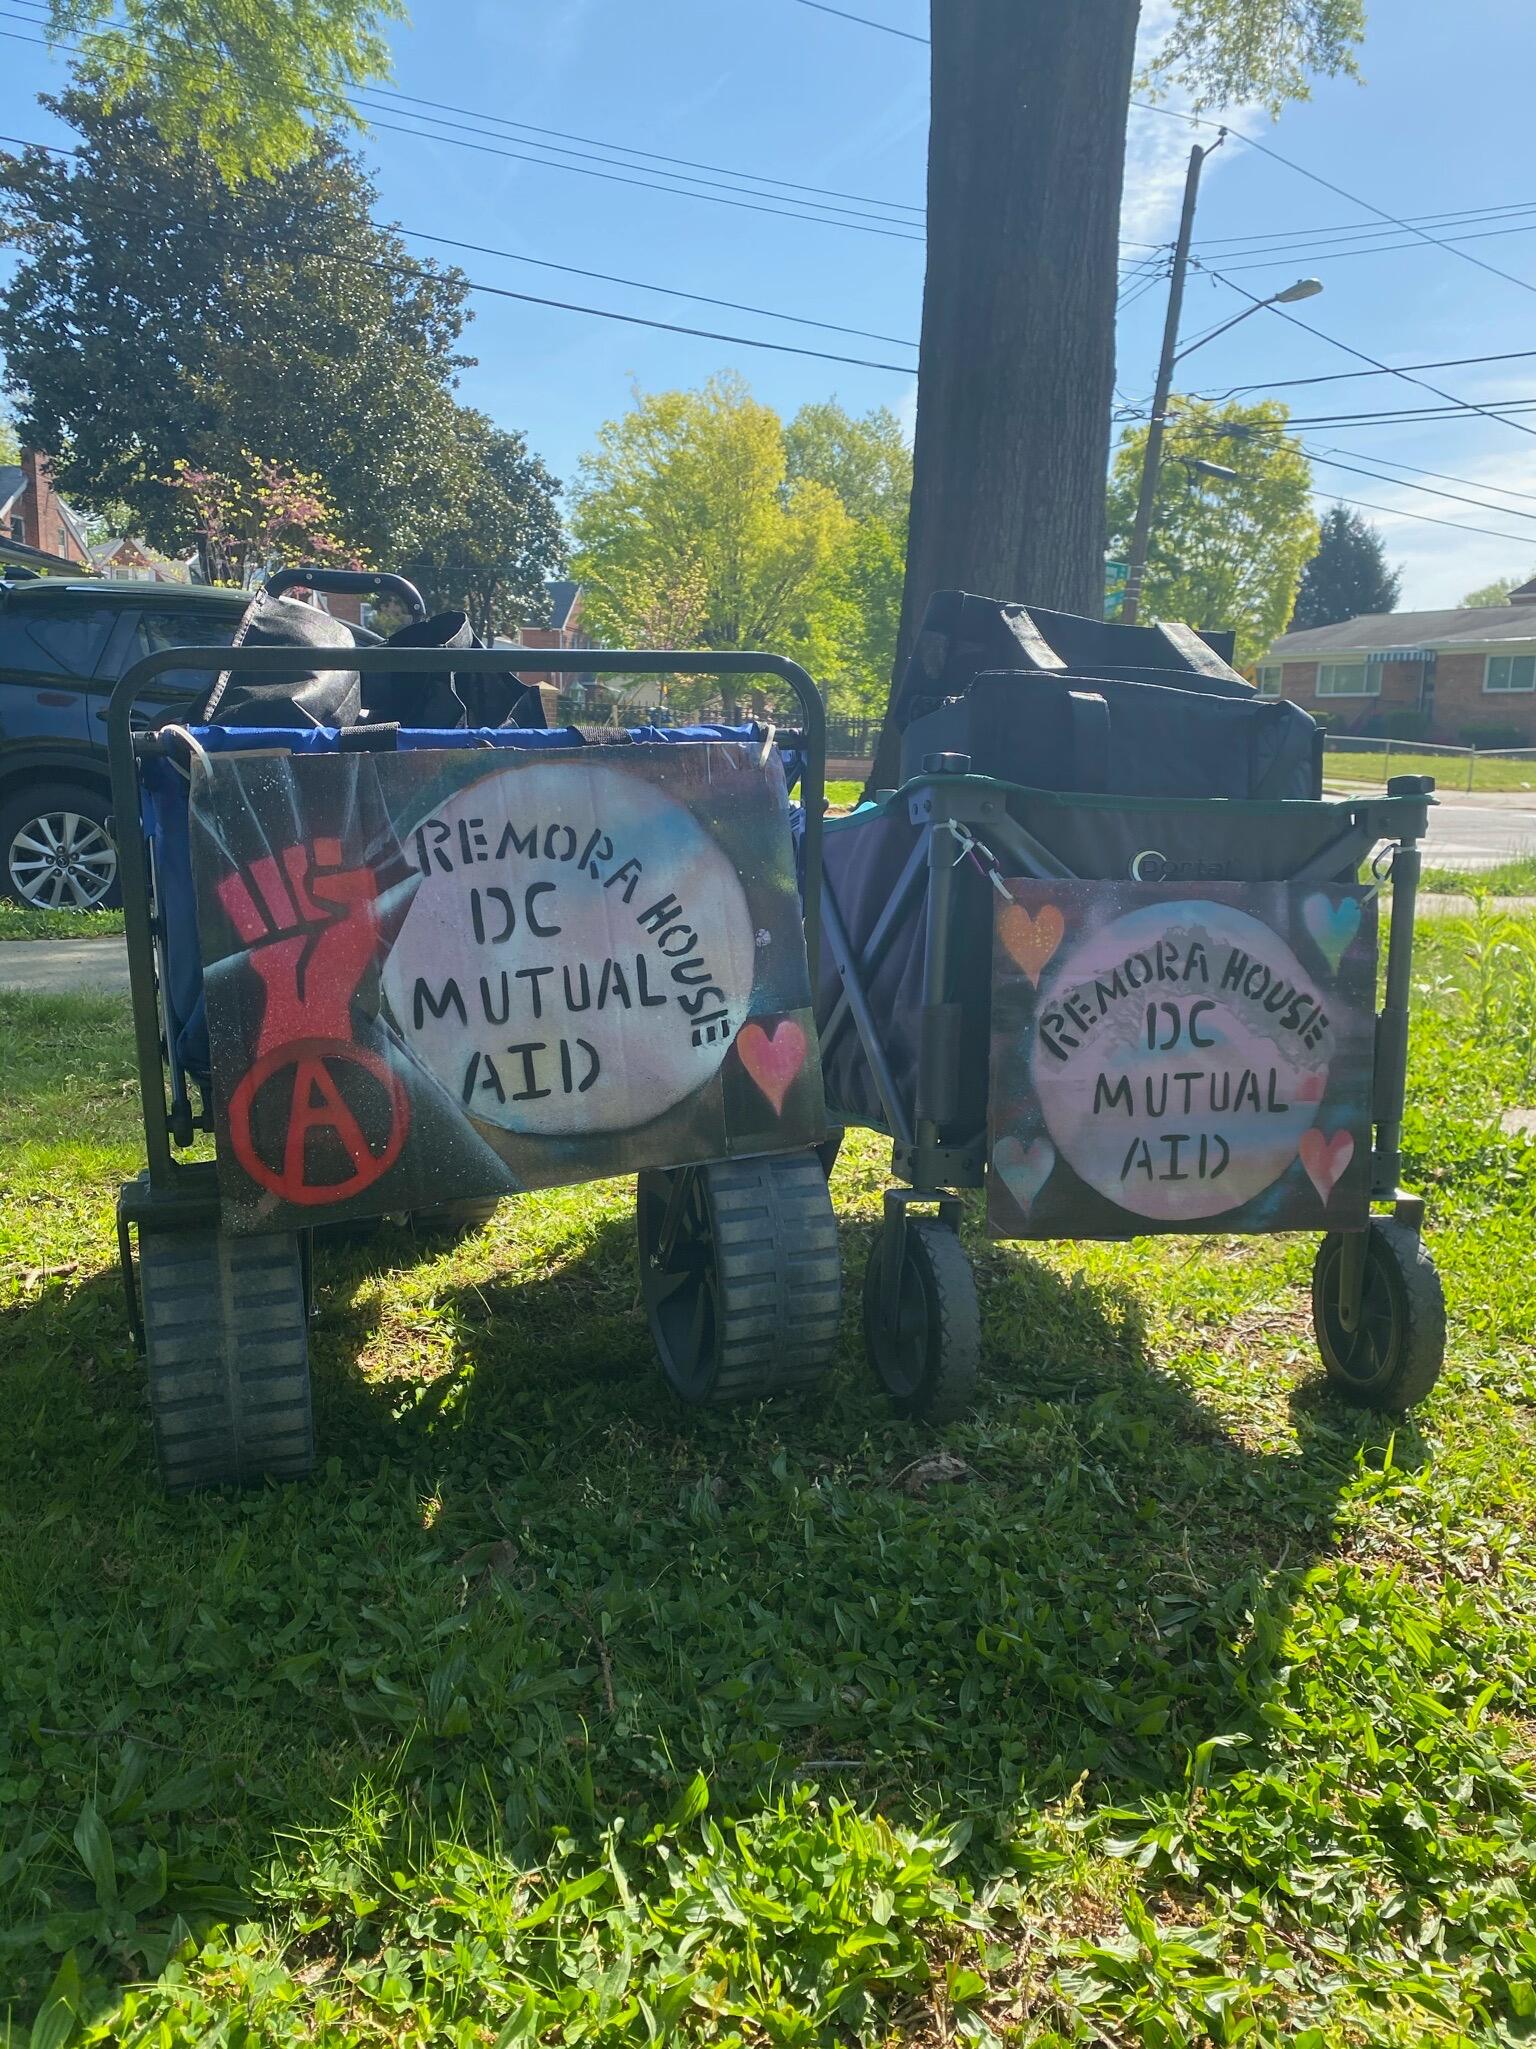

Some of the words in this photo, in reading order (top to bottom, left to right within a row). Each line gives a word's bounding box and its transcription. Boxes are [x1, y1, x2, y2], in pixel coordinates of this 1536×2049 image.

[415, 817, 642, 904] REMORA
[637, 892, 730, 1048] HOUSE
[470, 881, 562, 945] DC
[412, 953, 668, 1030] MUTUAL
[1039, 940, 1209, 1062] REMORA
[1220, 947, 1330, 1050] HOUSE
[1146, 1001, 1216, 1051] DC
[461, 1038, 601, 1104] AID
[1093, 1067, 1289, 1117] MUTUAL
[1120, 1133, 1231, 1181] AID
